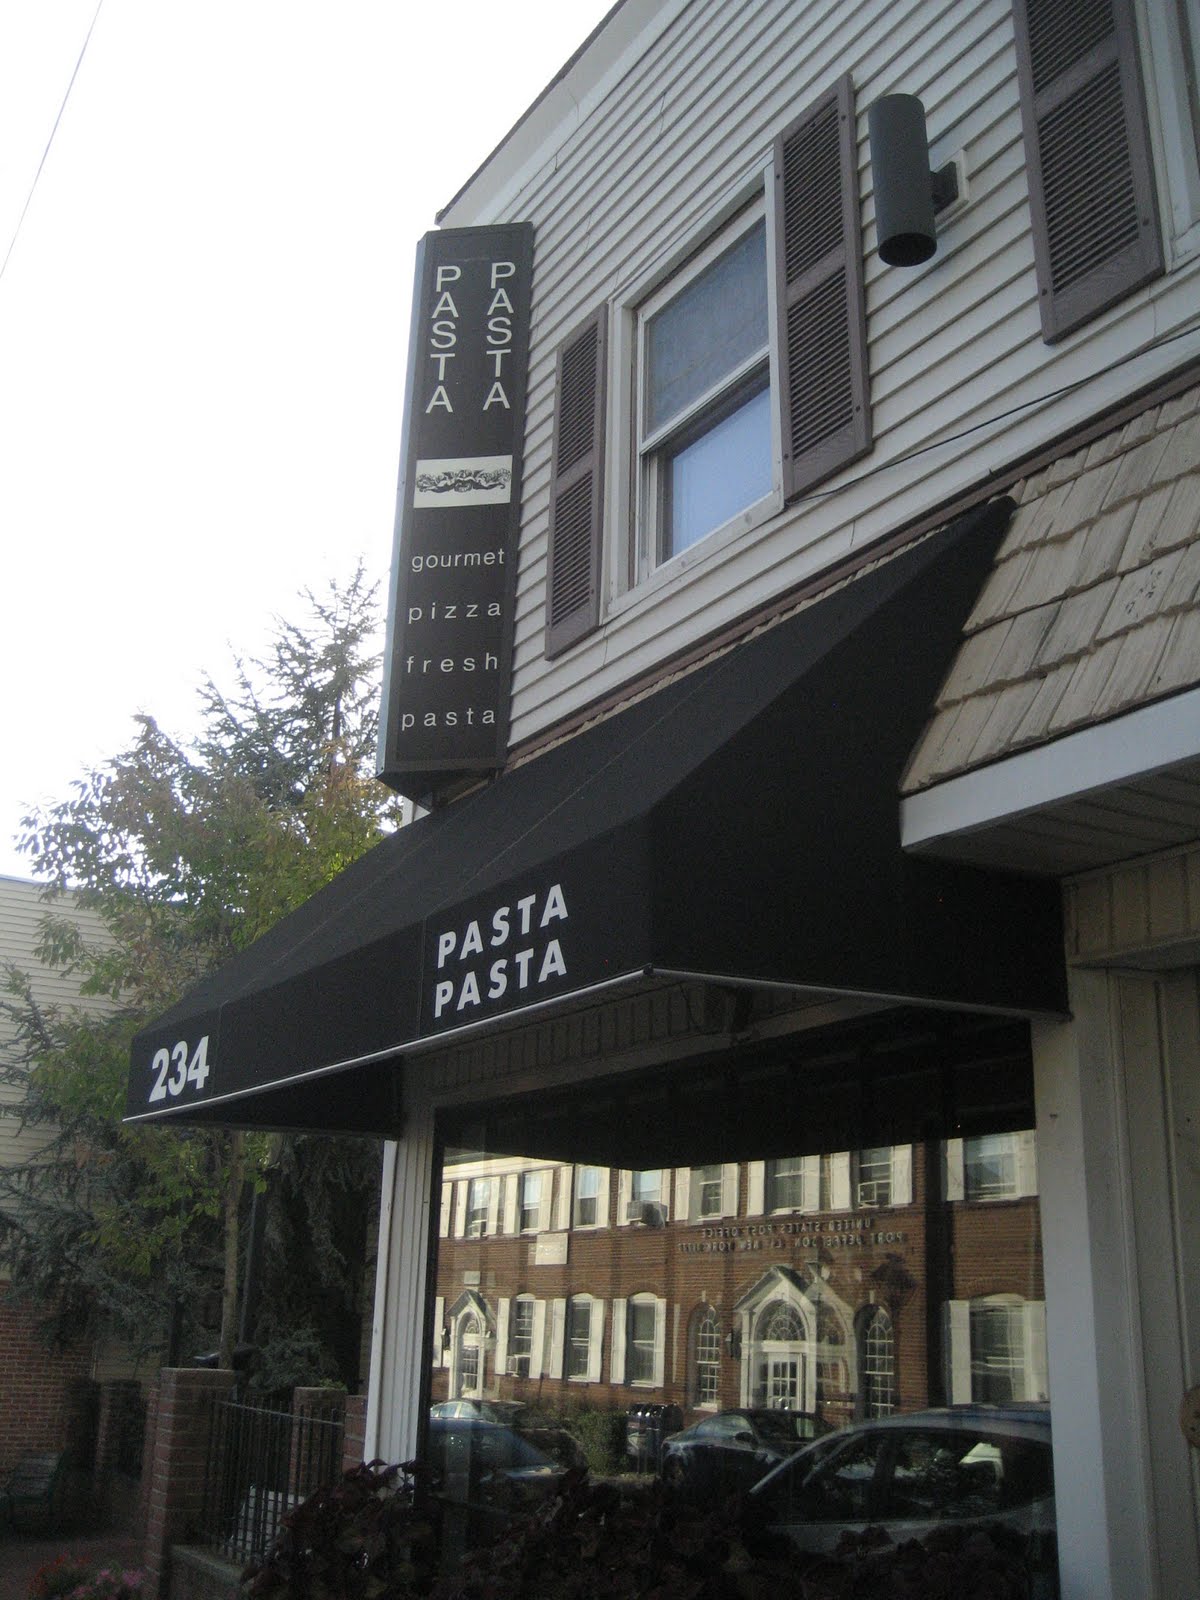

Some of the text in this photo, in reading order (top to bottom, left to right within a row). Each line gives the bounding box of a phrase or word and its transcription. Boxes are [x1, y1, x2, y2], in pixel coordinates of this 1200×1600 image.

[425, 265, 461, 413] PASTA
[483, 261, 516, 410] PASTA
[411, 548, 505, 572] gourmet
[408, 602, 501, 624] pizza
[406, 652, 498, 673] fresh
[402, 707, 495, 731] pasta
[437, 883, 569, 968] PASTA
[434, 938, 567, 1018] PASTA
[148, 1035, 210, 1102] 234
